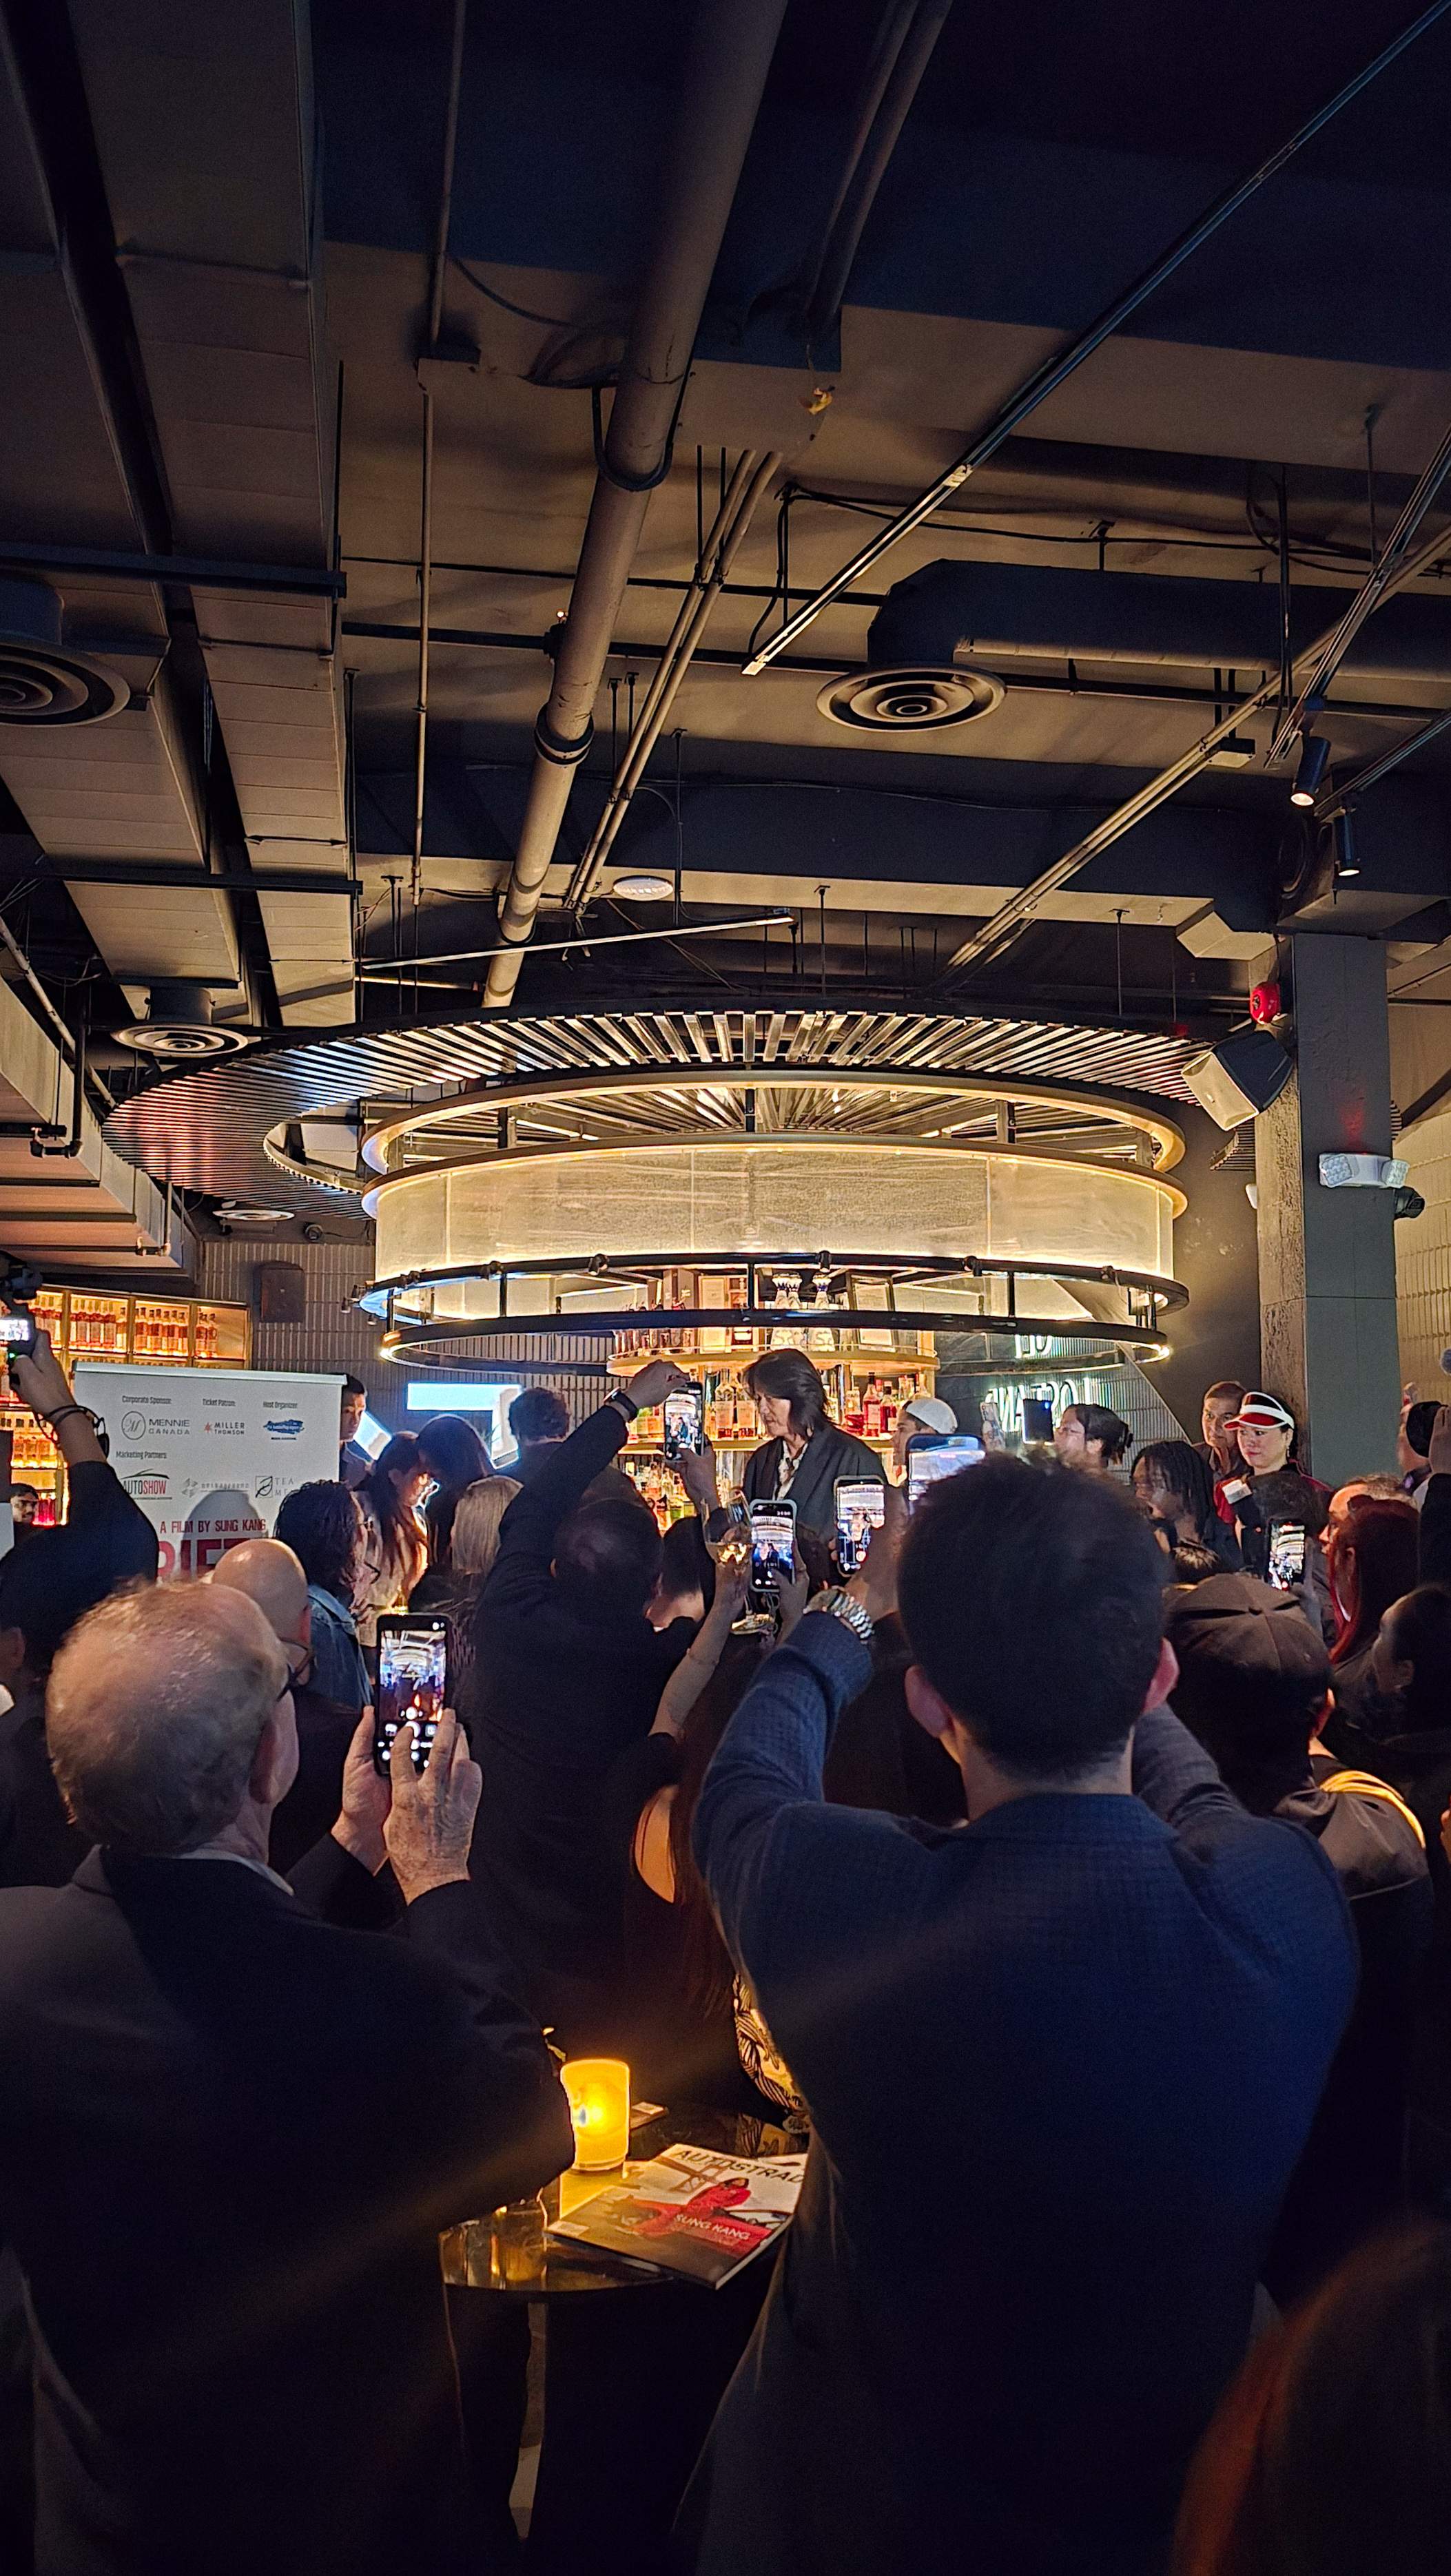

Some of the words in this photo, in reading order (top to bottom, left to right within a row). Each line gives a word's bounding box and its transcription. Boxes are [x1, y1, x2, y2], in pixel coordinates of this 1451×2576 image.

[148, 1418, 190, 1428] MENNIE
[116, 1451, 144, 1460] Marketing
[275, 1477, 294, 1486] TEA
[159, 1521, 167, 1534] A
[172, 1520, 194, 1533] FILM
[198, 1520, 210, 1533] BY
[215, 1519, 238, 1533] SUNG
[243, 1518, 267, 1533] KANG
[674, 2213, 712, 2230] SUNG
[712, 2222, 751, 2240] KANG
